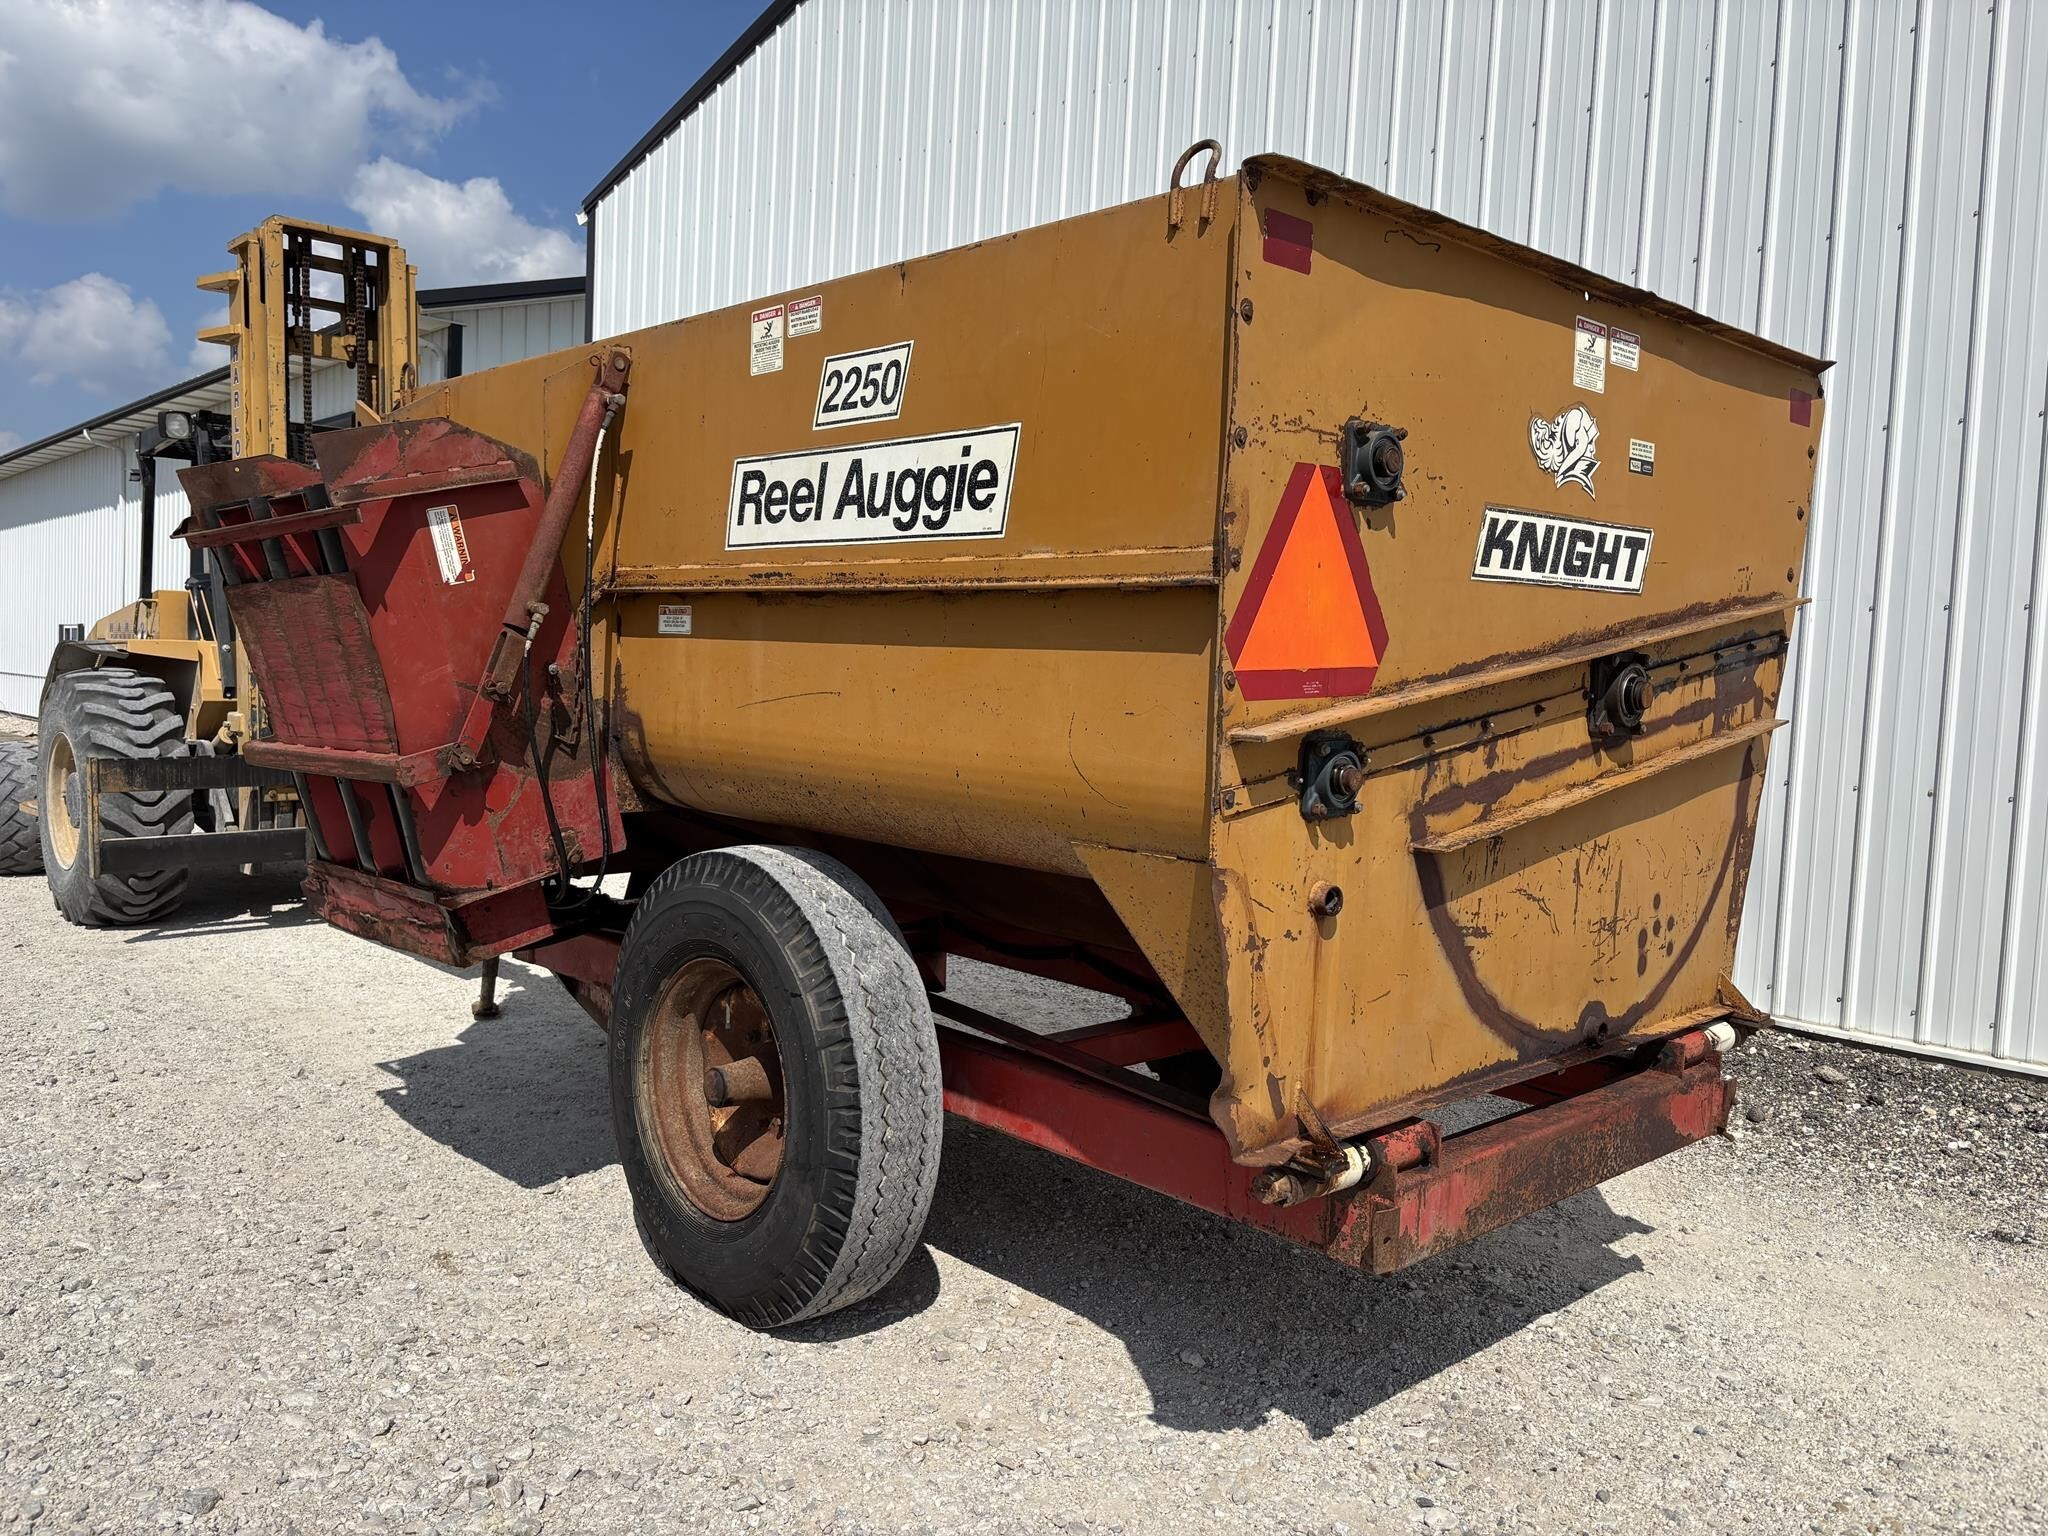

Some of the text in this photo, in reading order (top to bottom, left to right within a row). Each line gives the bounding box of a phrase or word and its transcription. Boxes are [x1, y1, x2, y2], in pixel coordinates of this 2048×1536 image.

[759, 310, 776, 320] DANGER
[232, 344, 241, 458] HARLO
[821, 359, 902, 414] 2250
[737, 445, 999, 532] Reel Auggie
[1480, 517, 1647, 582] KNIGHT
